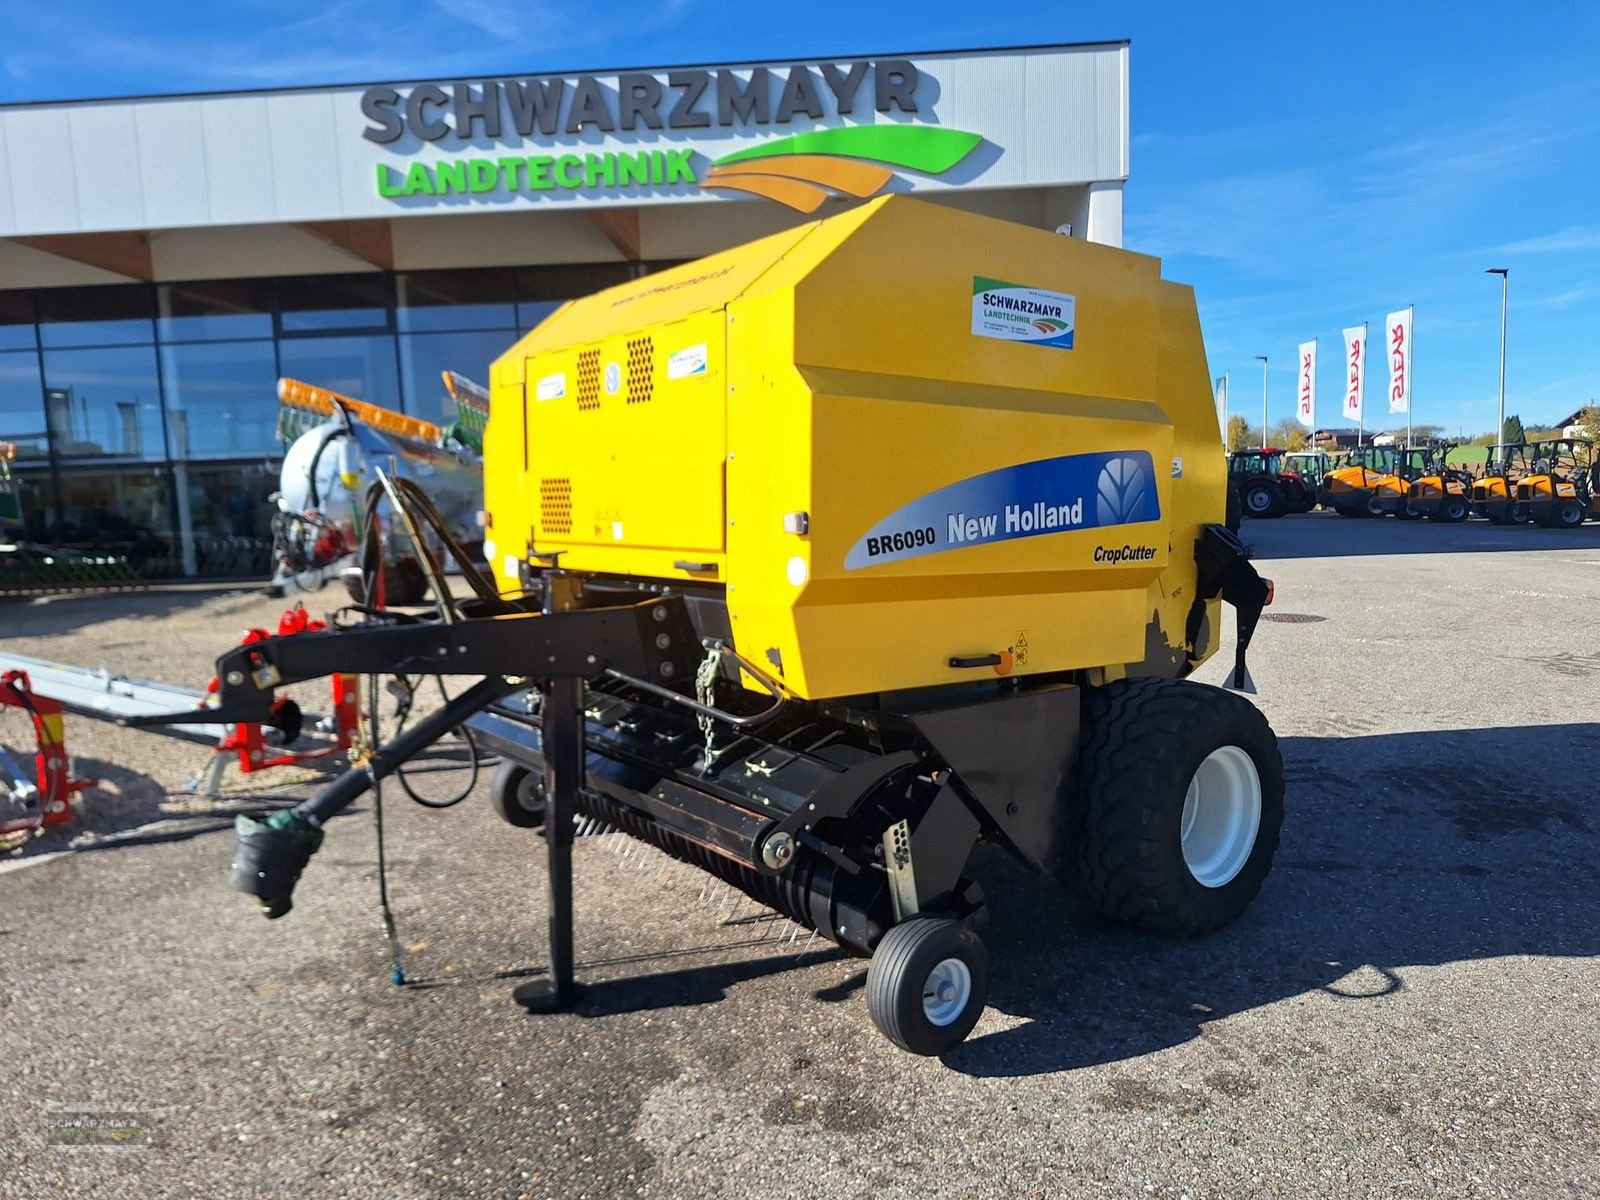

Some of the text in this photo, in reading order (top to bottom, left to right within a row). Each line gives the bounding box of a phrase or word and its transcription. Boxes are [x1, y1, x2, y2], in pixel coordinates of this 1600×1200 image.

[361, 60, 918, 144] SCHWARZMAYR
[376, 149, 696, 197] LANDTECHNIK
[983, 293, 1062, 318] SCHWARZMAYR
[983, 309, 1031, 324] LANDTECHNIK
[867, 498, 1083, 556] BR6090 New Holland
[1093, 543, 1157, 565] CropCutter
